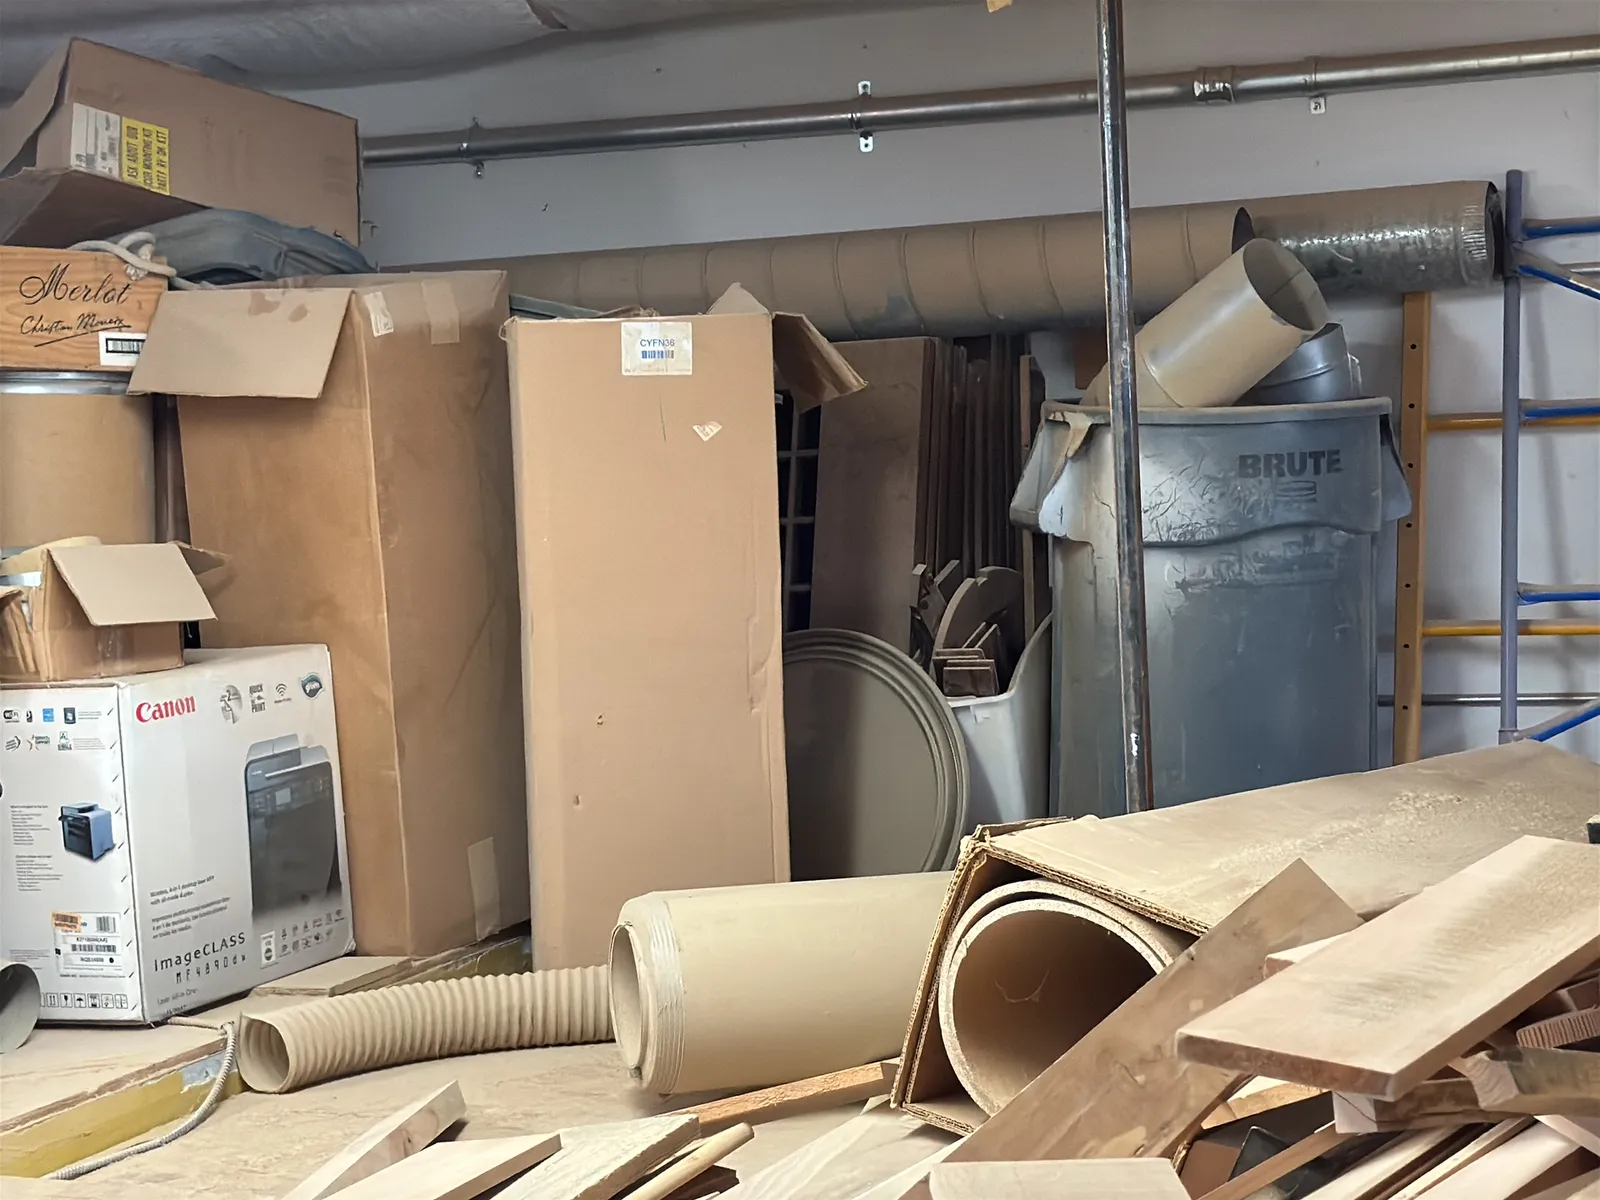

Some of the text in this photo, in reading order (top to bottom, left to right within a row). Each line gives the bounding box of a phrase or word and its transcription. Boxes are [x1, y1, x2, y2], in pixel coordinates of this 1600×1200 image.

[127, 141, 139, 163] ABOUT
[19, 263, 131, 305] Merlot
[640, 339, 675, 347] CYFN36
[1238, 449, 1344, 479] BRUTE
[136, 695, 196, 723] Canon
